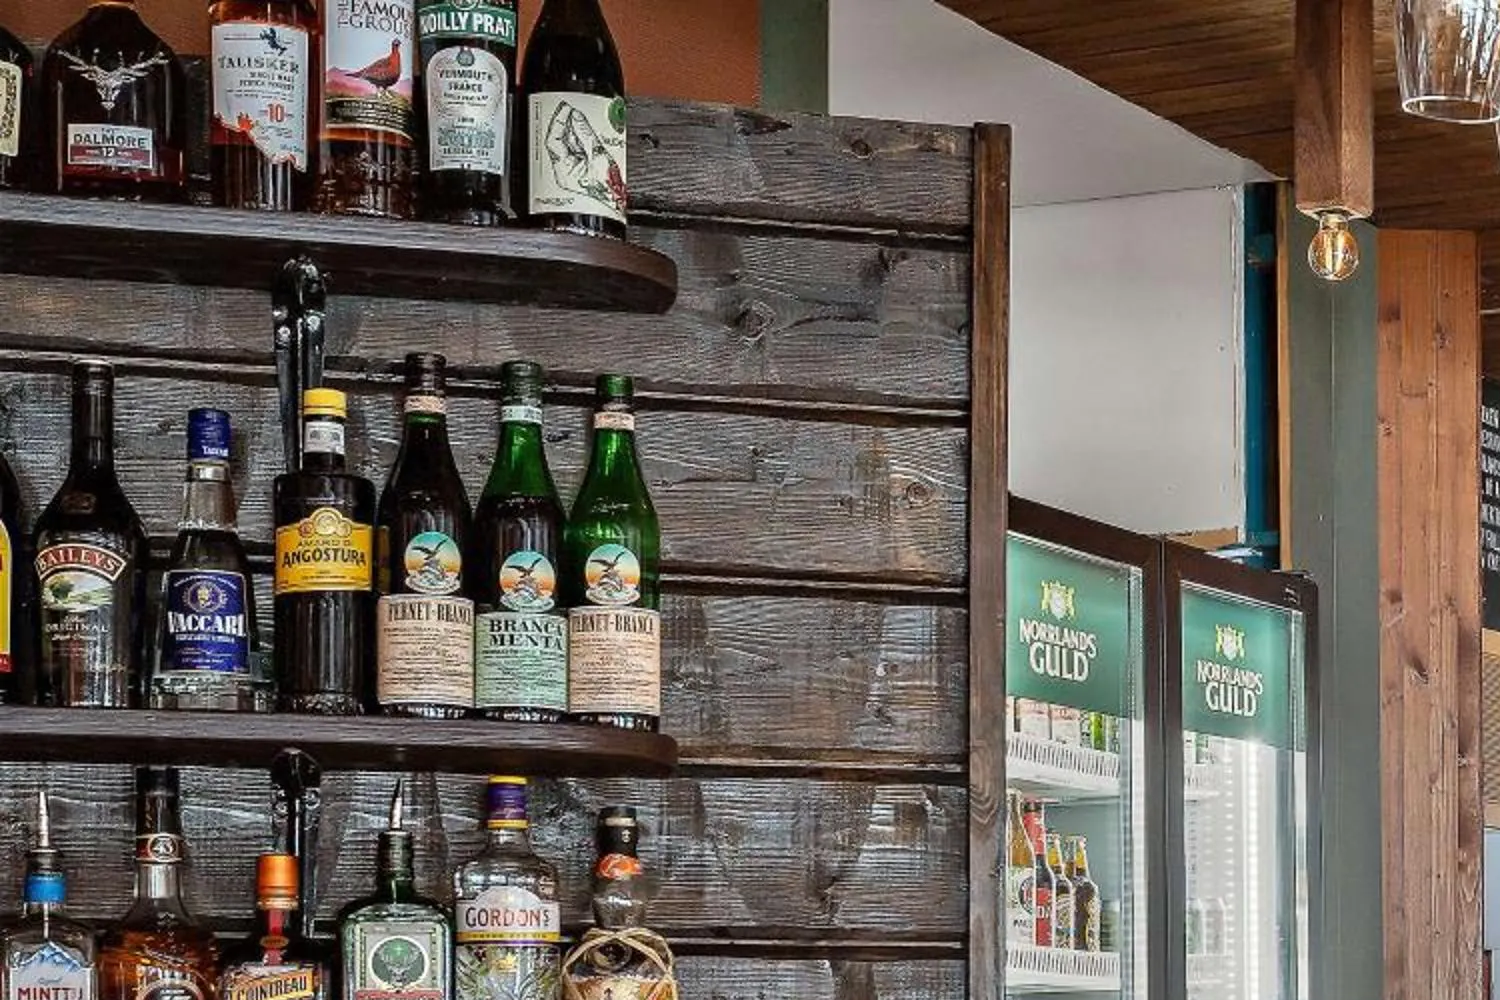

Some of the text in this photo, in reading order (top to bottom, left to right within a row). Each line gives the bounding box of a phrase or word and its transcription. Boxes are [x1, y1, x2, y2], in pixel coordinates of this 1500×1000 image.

[420, 11, 514, 40] NOILLY PRAT
[218, 56, 300, 75] TALISKER
[267, 103, 285, 122] 10
[73, 133, 149, 149] DALMORE
[102, 147, 115, 157] 12
[37, 547, 119, 573] BAILEYS
[281, 547, 367, 568] ANGOSTURA
[489, 634, 563, 651] MENTA
[1019, 618, 1097, 659] NORRLANDS
[1029, 642, 1089, 682] GULD
[1197, 660, 1263, 696] NORRLANDS
[1205, 682, 1257, 717] GULD
